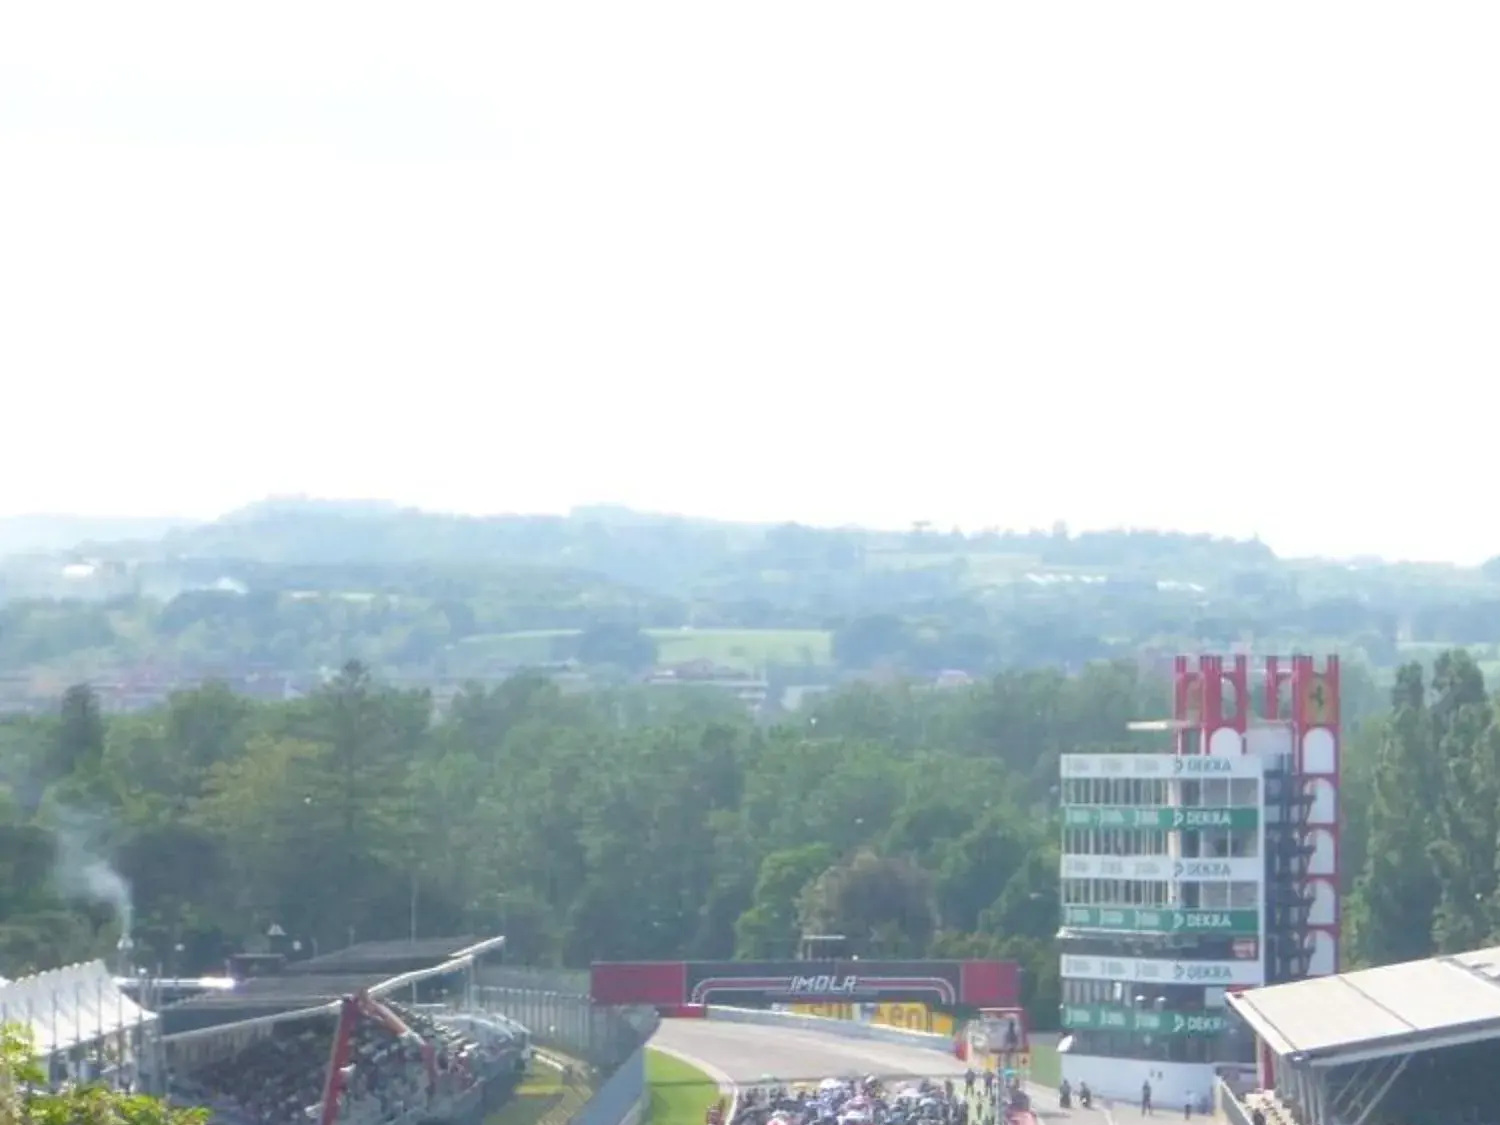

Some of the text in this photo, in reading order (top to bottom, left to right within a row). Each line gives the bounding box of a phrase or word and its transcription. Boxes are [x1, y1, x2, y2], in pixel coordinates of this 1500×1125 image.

[1187, 758, 1232, 773] DEKRA
[1186, 810, 1232, 826] DEKRA
[1187, 862, 1232, 877] DEKRA
[1186, 912, 1232, 928] DEKRA
[1187, 964, 1233, 979] DEKRA
[789, 975, 857, 992] IMOLA
